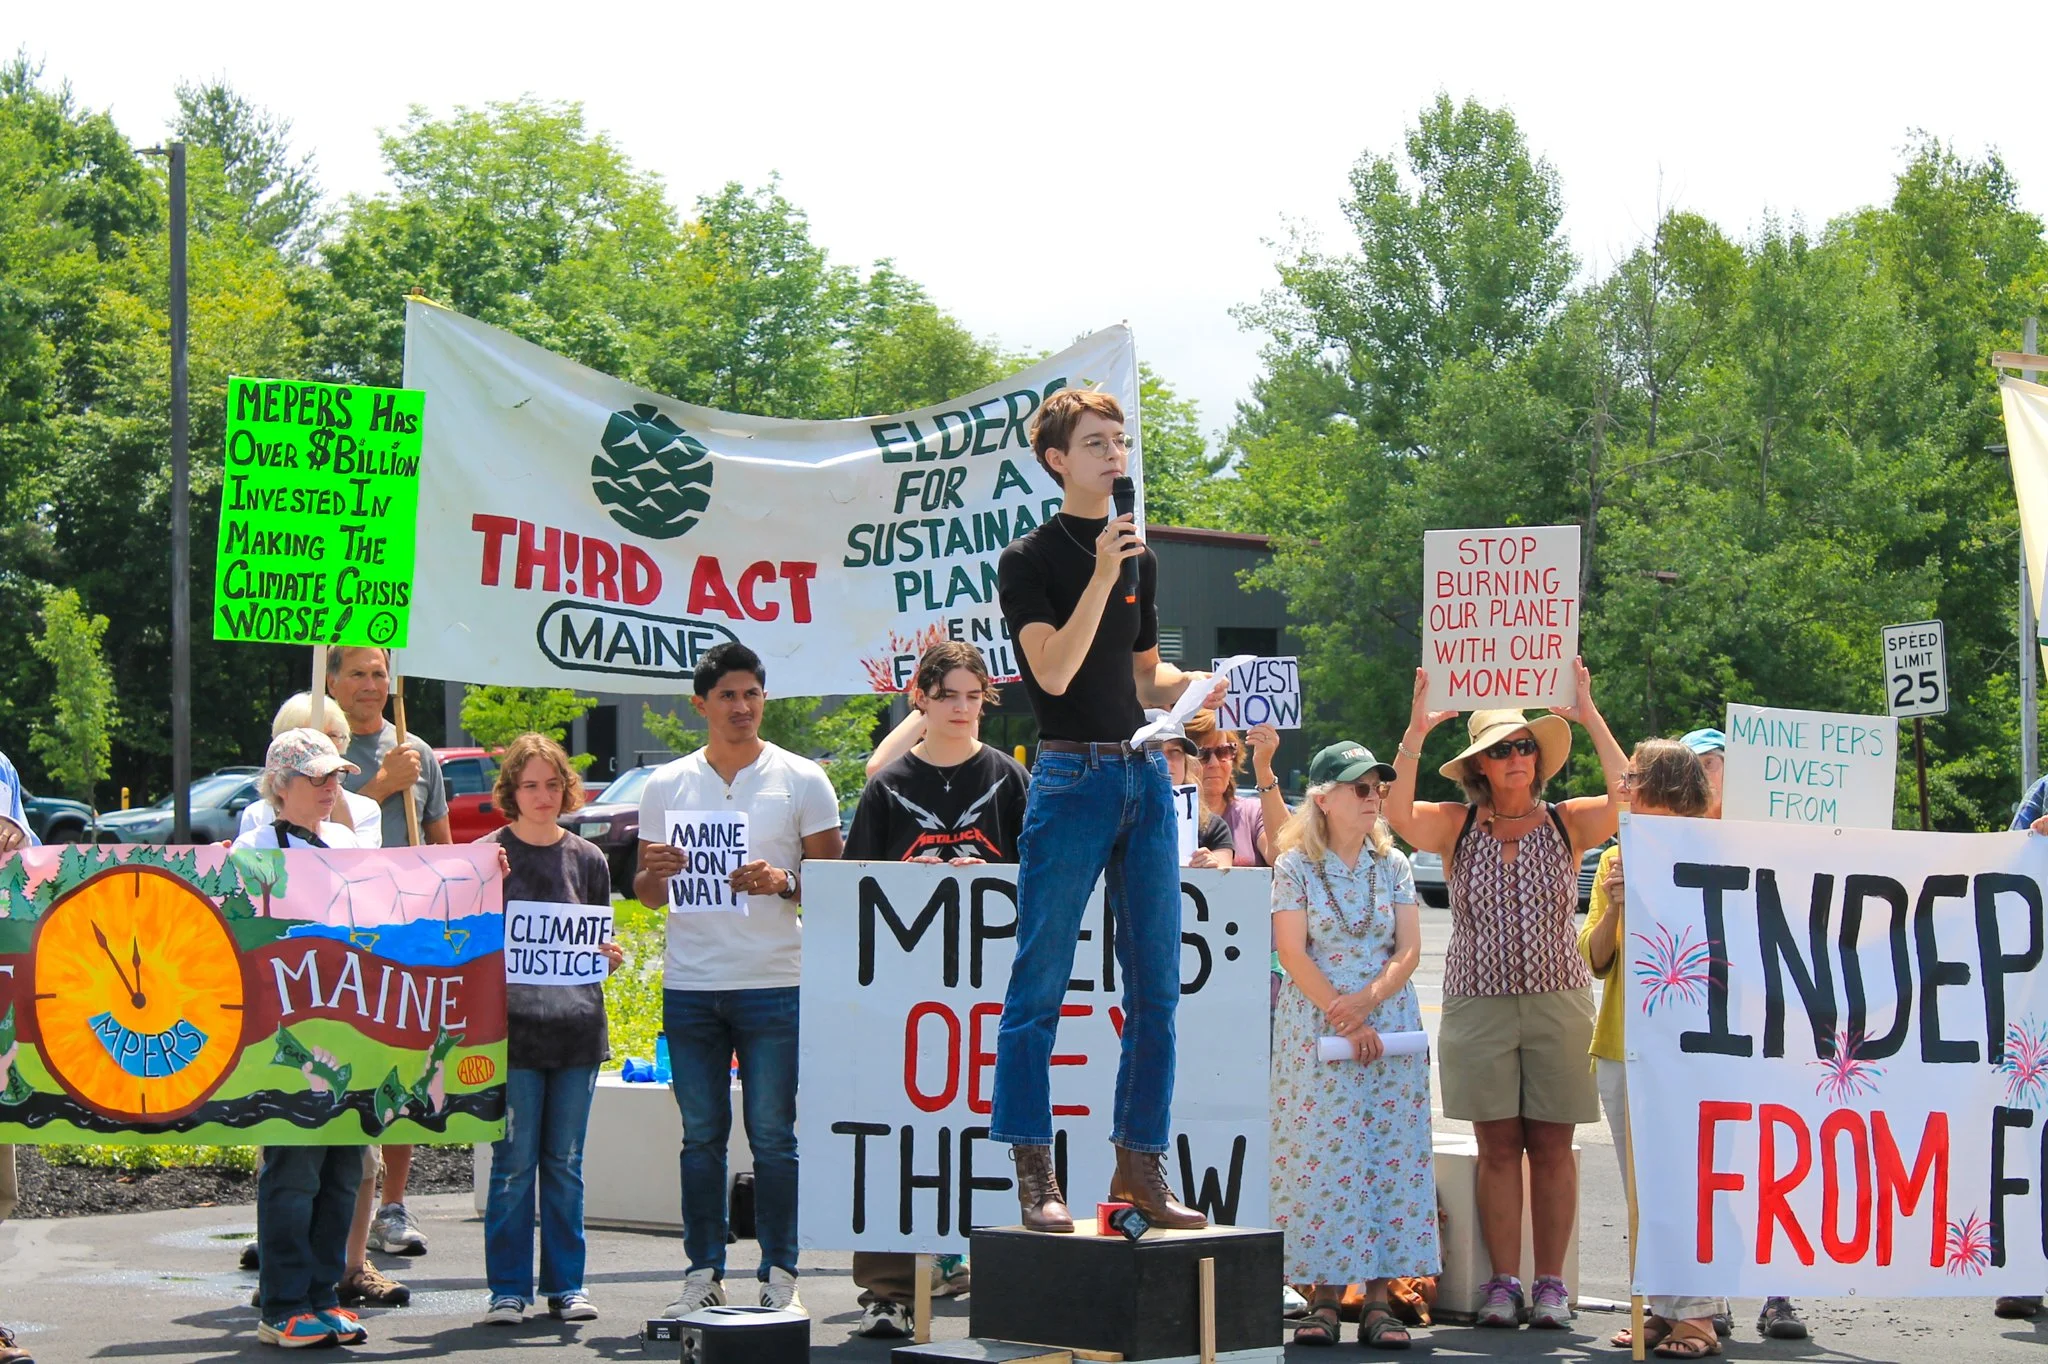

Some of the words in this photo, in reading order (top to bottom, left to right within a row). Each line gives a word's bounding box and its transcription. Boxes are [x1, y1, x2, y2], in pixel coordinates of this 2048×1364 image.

[236, 383, 353, 430] MEPERS
[369, 393, 418, 434] HAS
[229, 429, 299, 469] OVER
[228, 474, 346, 515] INVESTED
[349, 478, 392, 518] IN
[894, 466, 968, 514] FOR
[992, 459, 1034, 500] A
[224, 520, 325, 561] MAKING
[339, 524, 387, 565] THE
[1458, 536, 1537, 565] STOP
[223, 559, 327, 604] CLIMATE
[336, 566, 409, 608] CRISIS
[687, 555, 818, 624] ACT
[1437, 567, 1560, 599] BURNING
[1430, 602, 1478, 632] OUR
[1490, 599, 1574, 627] PLANET
[1434, 638, 1496, 664] WITH
[1510, 633, 1562, 661] OUR
[1888, 632, 1938, 651] SPEED
[1213, 660, 1298, 695] IVEST
[1895, 652, 1933, 669] LIMIT
[1449, 667, 1558, 698] MONEY!
[1892, 671, 1940, 708] 25
[1218, 693, 1299, 728] NOW
[1732, 714, 1809, 749] MAINE
[1821, 723, 1884, 757] PERS
[1764, 756, 1850, 789] DIVEST
[1769, 791, 1838, 824] FROM
[671, 823, 745, 848] MAINE
[510, 914, 612, 945] CLIMATE
[507, 949, 603, 976] JUSTICE
[270, 949, 467, 1033] MAINE
[92, 1016, 204, 1078] MPERS
[283, 1044, 306, 1063] GAS
[383, 1084, 396, 1103] OIL
[831, 1120, 1013, 1238] THE
[1696, 1100, 1949, 1268] FROM
[1990, 1105, 2048, 1267] F
